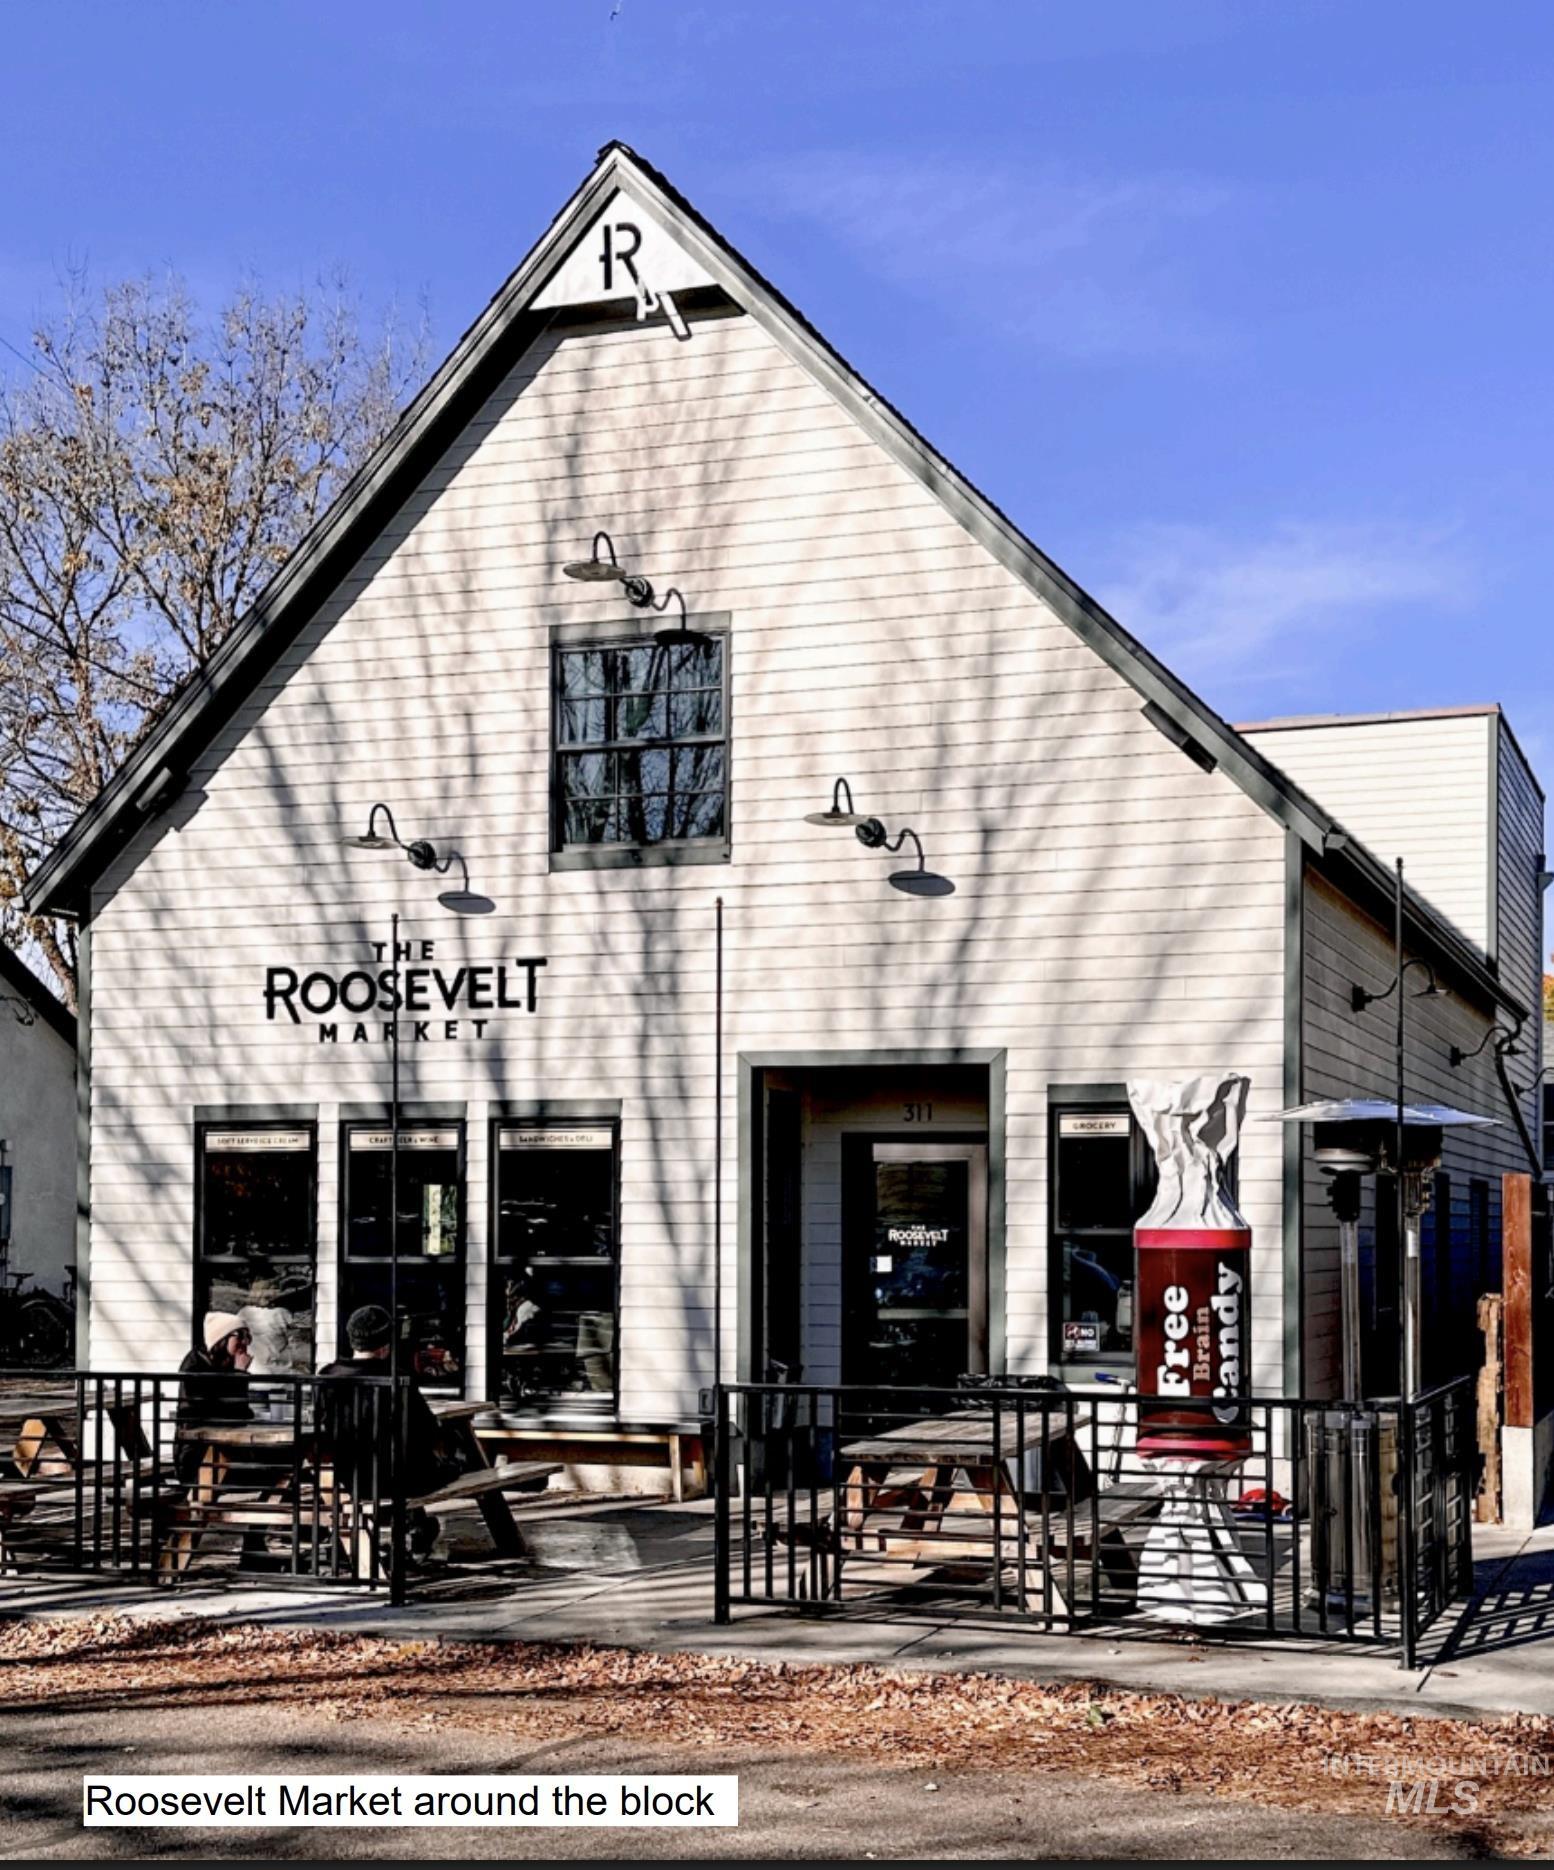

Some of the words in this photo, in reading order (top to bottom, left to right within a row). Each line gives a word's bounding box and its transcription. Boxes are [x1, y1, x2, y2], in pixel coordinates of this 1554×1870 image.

[372, 940, 436, 963] THE
[263, 957, 548, 1024] ROOSEVELT
[319, 1019, 488, 1043] MARKET
[903, 1103, 933, 1122] 311
[1072, 1121, 1116, 1130] GROCERY
[368, 1135, 393, 1145] CRAFT
[888, 1229, 949, 1243] ROOSEVELT
[1080, 1327, 1095, 1338] NO
[1157, 1285, 1190, 1396] Free
[1193, 1306, 1211, 1381] Brain
[1210, 1261, 1243, 1424] Candy
